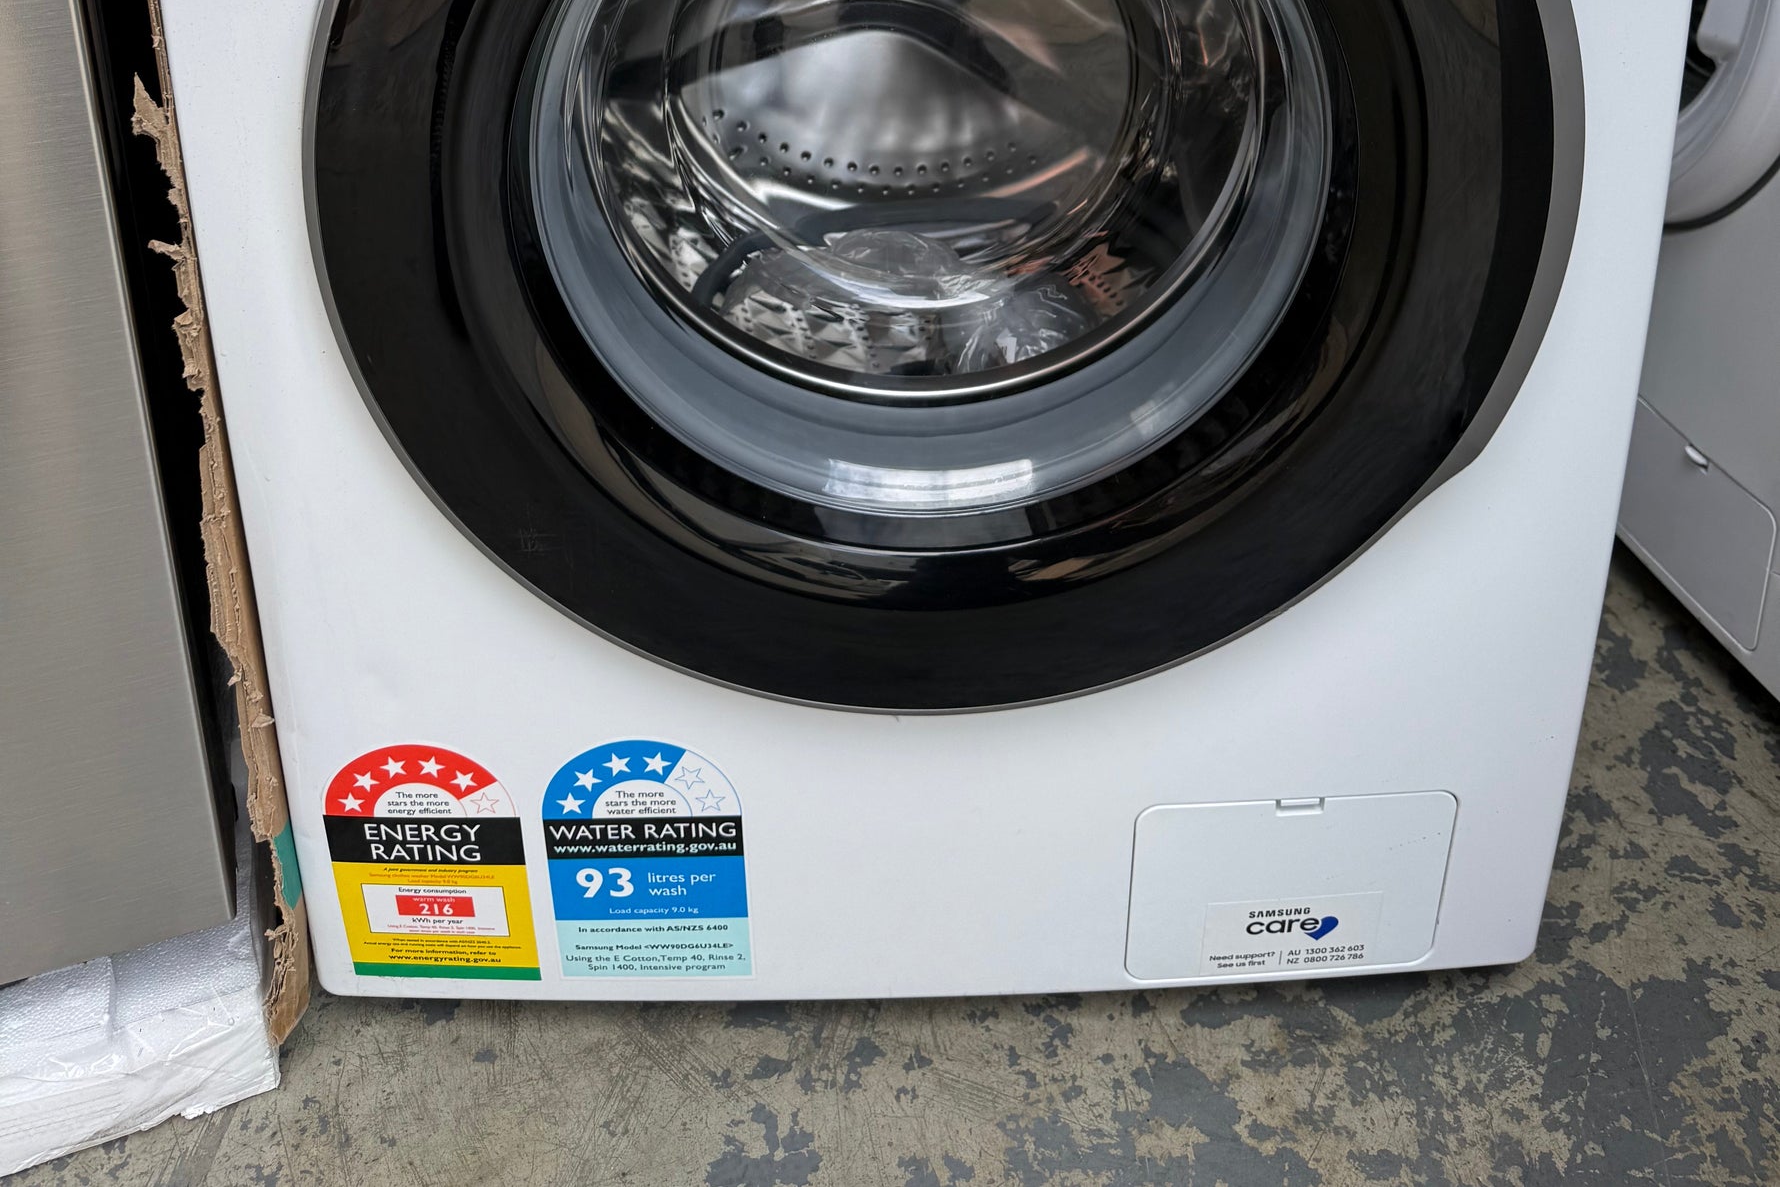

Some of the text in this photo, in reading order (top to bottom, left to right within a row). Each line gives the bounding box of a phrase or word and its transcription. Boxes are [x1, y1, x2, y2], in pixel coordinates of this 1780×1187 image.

[616, 790, 635, 798] The
[632, 798, 648, 806] the
[364, 824, 481, 841] ENERGY
[549, 822, 737, 841] WATER RATING
[370, 844, 481, 861] RATING
[554, 842, 737, 854] www.waterrating.gov.au
[576, 868, 716, 898] 93 litres per
[649, 886, 687, 896] wash
[419, 902, 454, 915] 216
[634, 907, 669, 915] capacity
[688, 907, 699, 915] kg
[1249, 907, 1311, 919] SAMSUNG
[1246, 917, 1320, 935] care
[1347, 944, 1364, 952] 603
[389, 955, 501, 963] www.energyrating.gov.au
[566, 955, 592, 963] Using
[1235, 951, 1275, 960] support?
